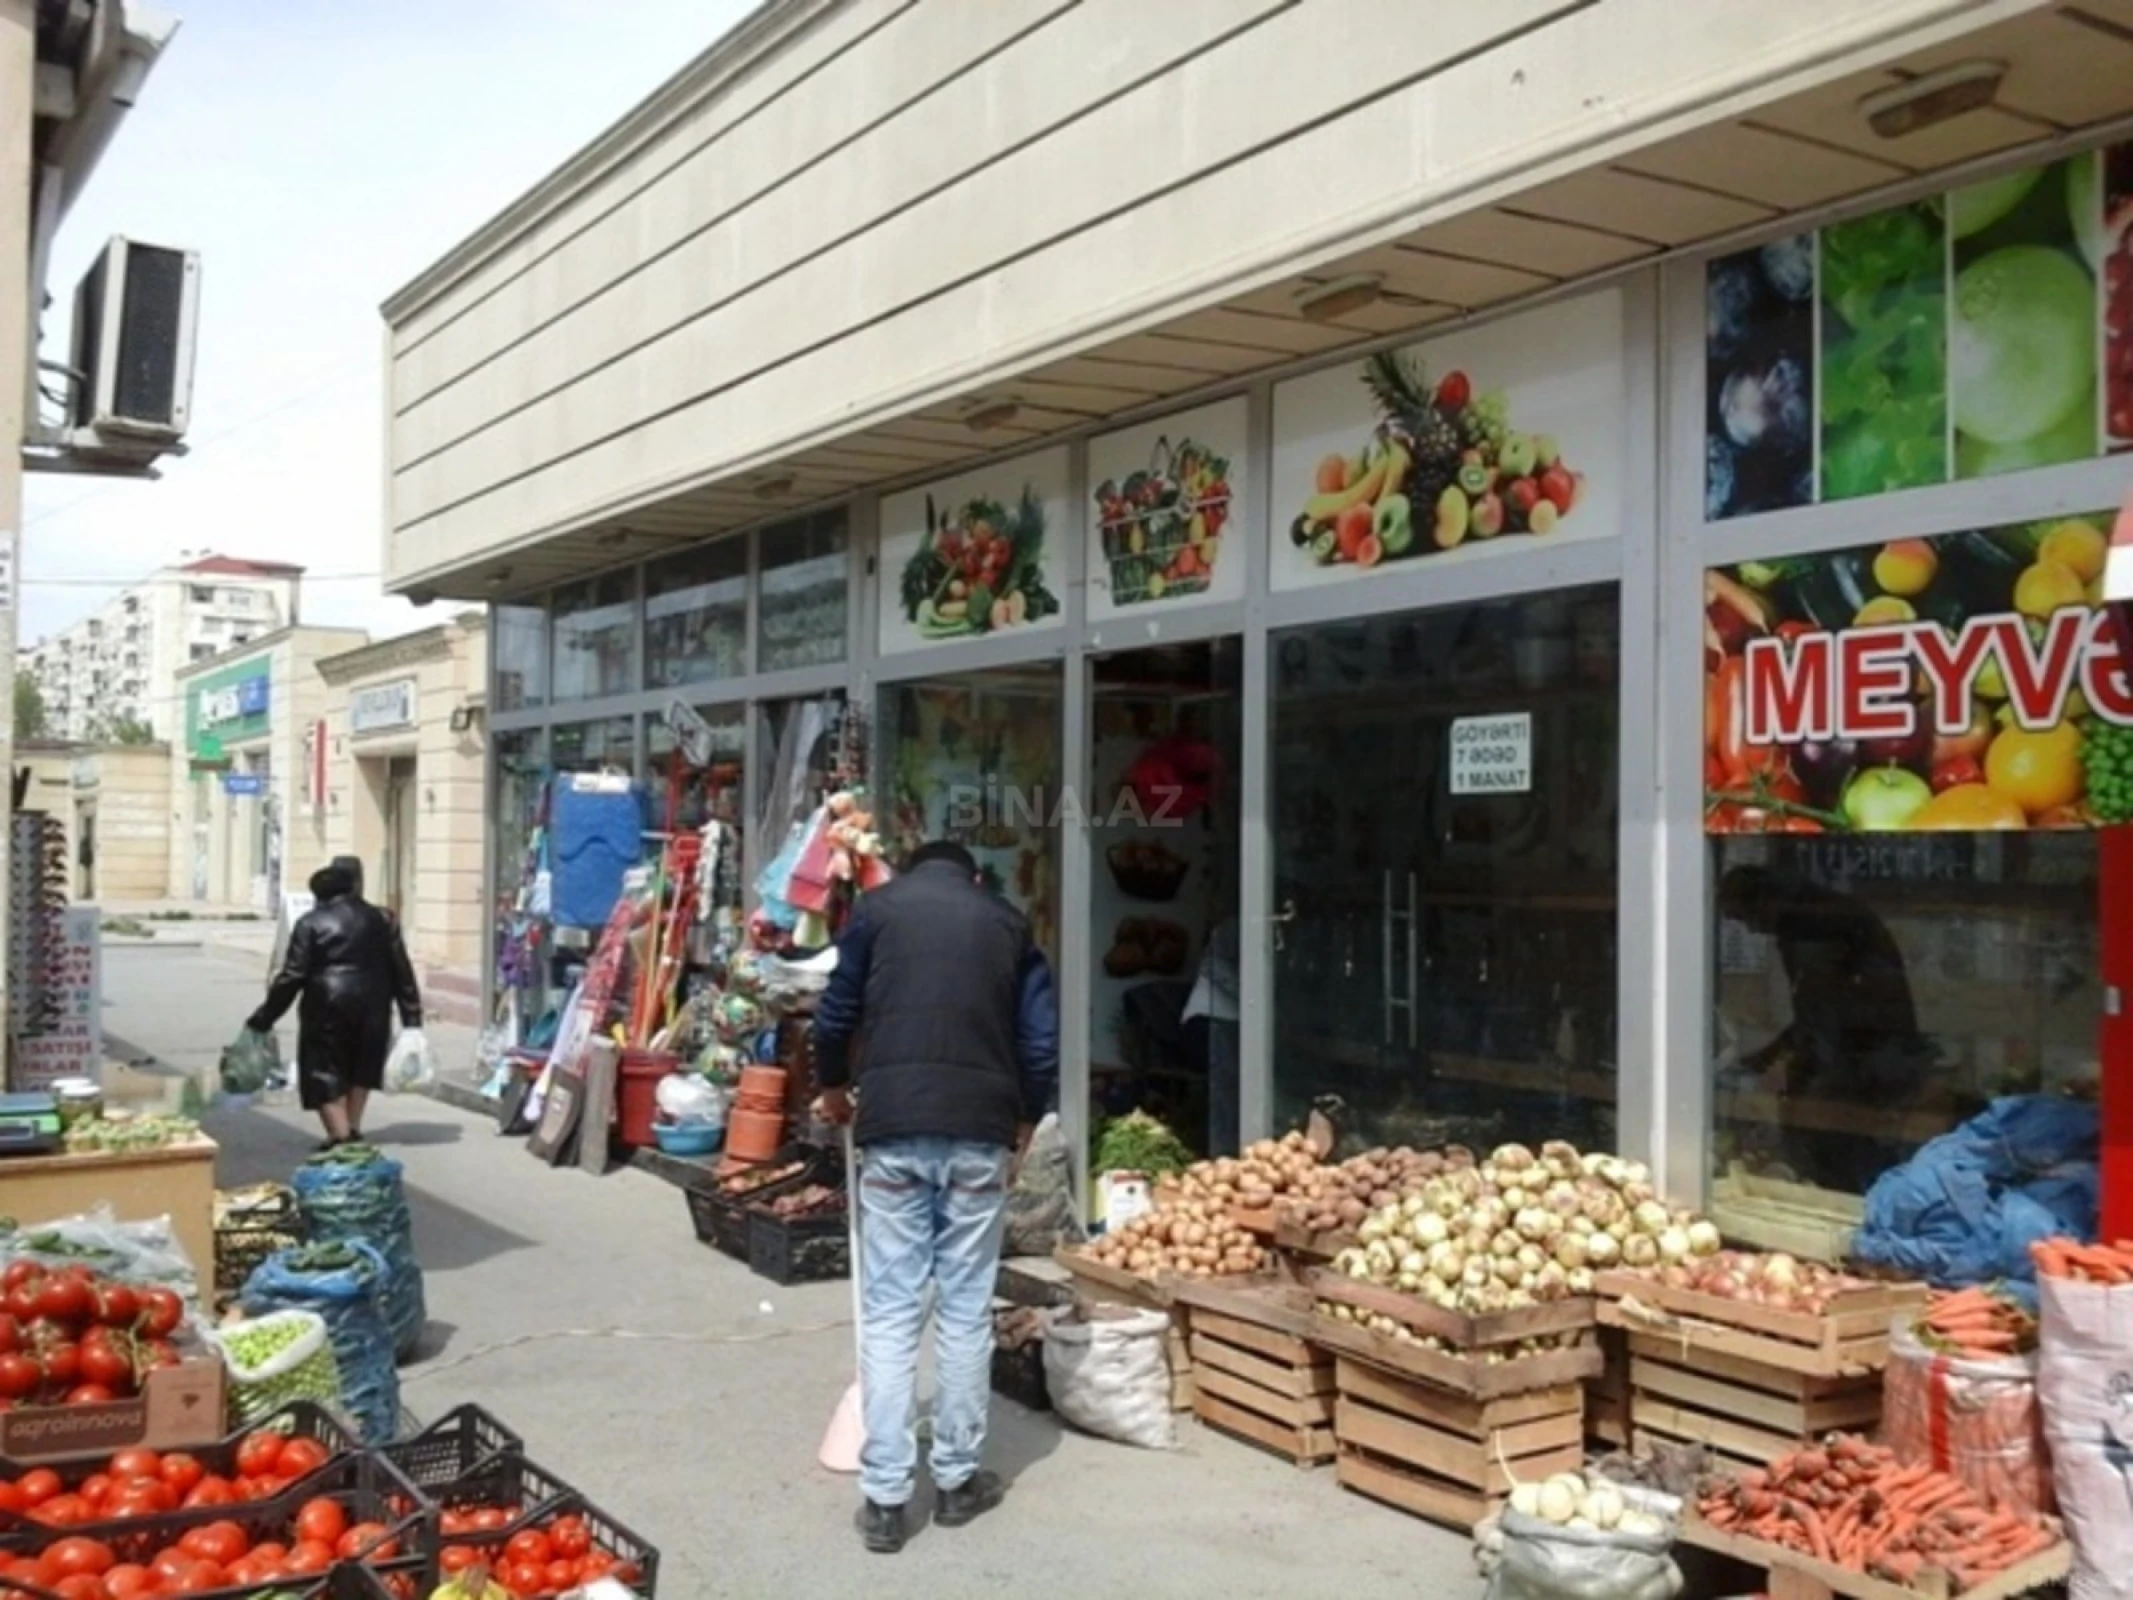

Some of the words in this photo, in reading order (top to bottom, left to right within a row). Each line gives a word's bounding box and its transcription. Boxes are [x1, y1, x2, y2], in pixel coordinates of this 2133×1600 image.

[1457, 772, 1465, 788] 1
[1469, 770, 1526, 787] MANAT
[9, 1411, 142, 1441] agroinnova
